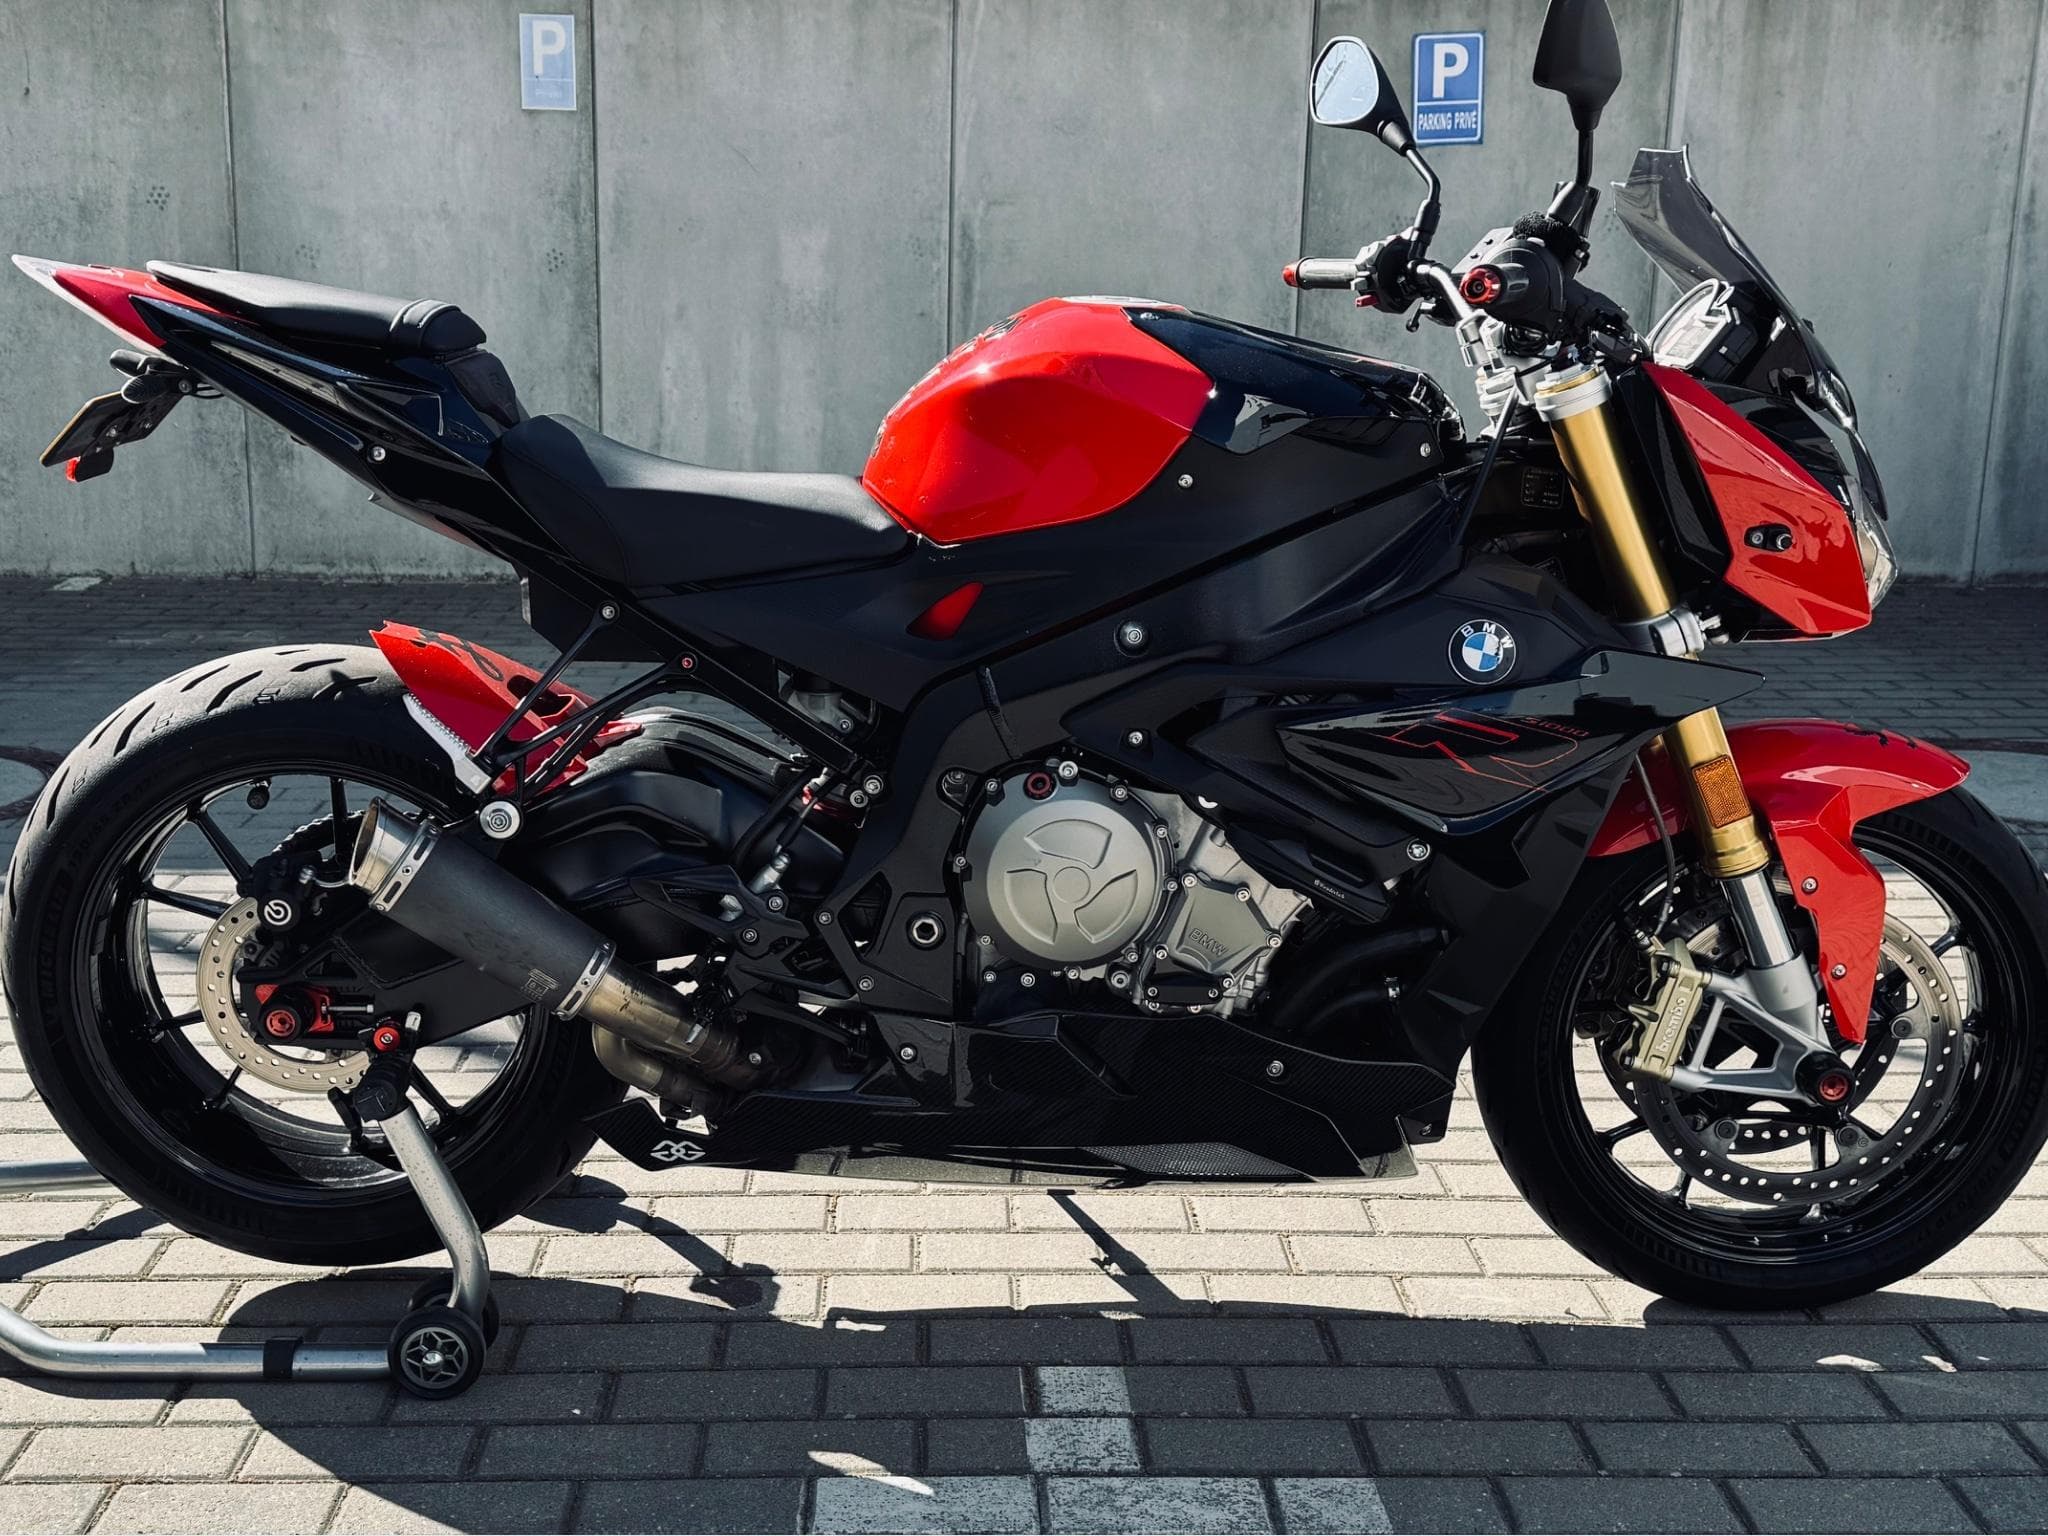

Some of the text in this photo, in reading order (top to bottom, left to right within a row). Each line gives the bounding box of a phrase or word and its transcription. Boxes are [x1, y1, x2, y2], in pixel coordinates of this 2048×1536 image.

[532, 20, 566, 75] P
[1432, 42, 1469, 98] P
[1418, 112, 1453, 130] PARKING
[1461, 622, 1514, 648] BMW
[1189, 927, 1229, 957] BMW
[1655, 997, 1686, 1052] brembo
